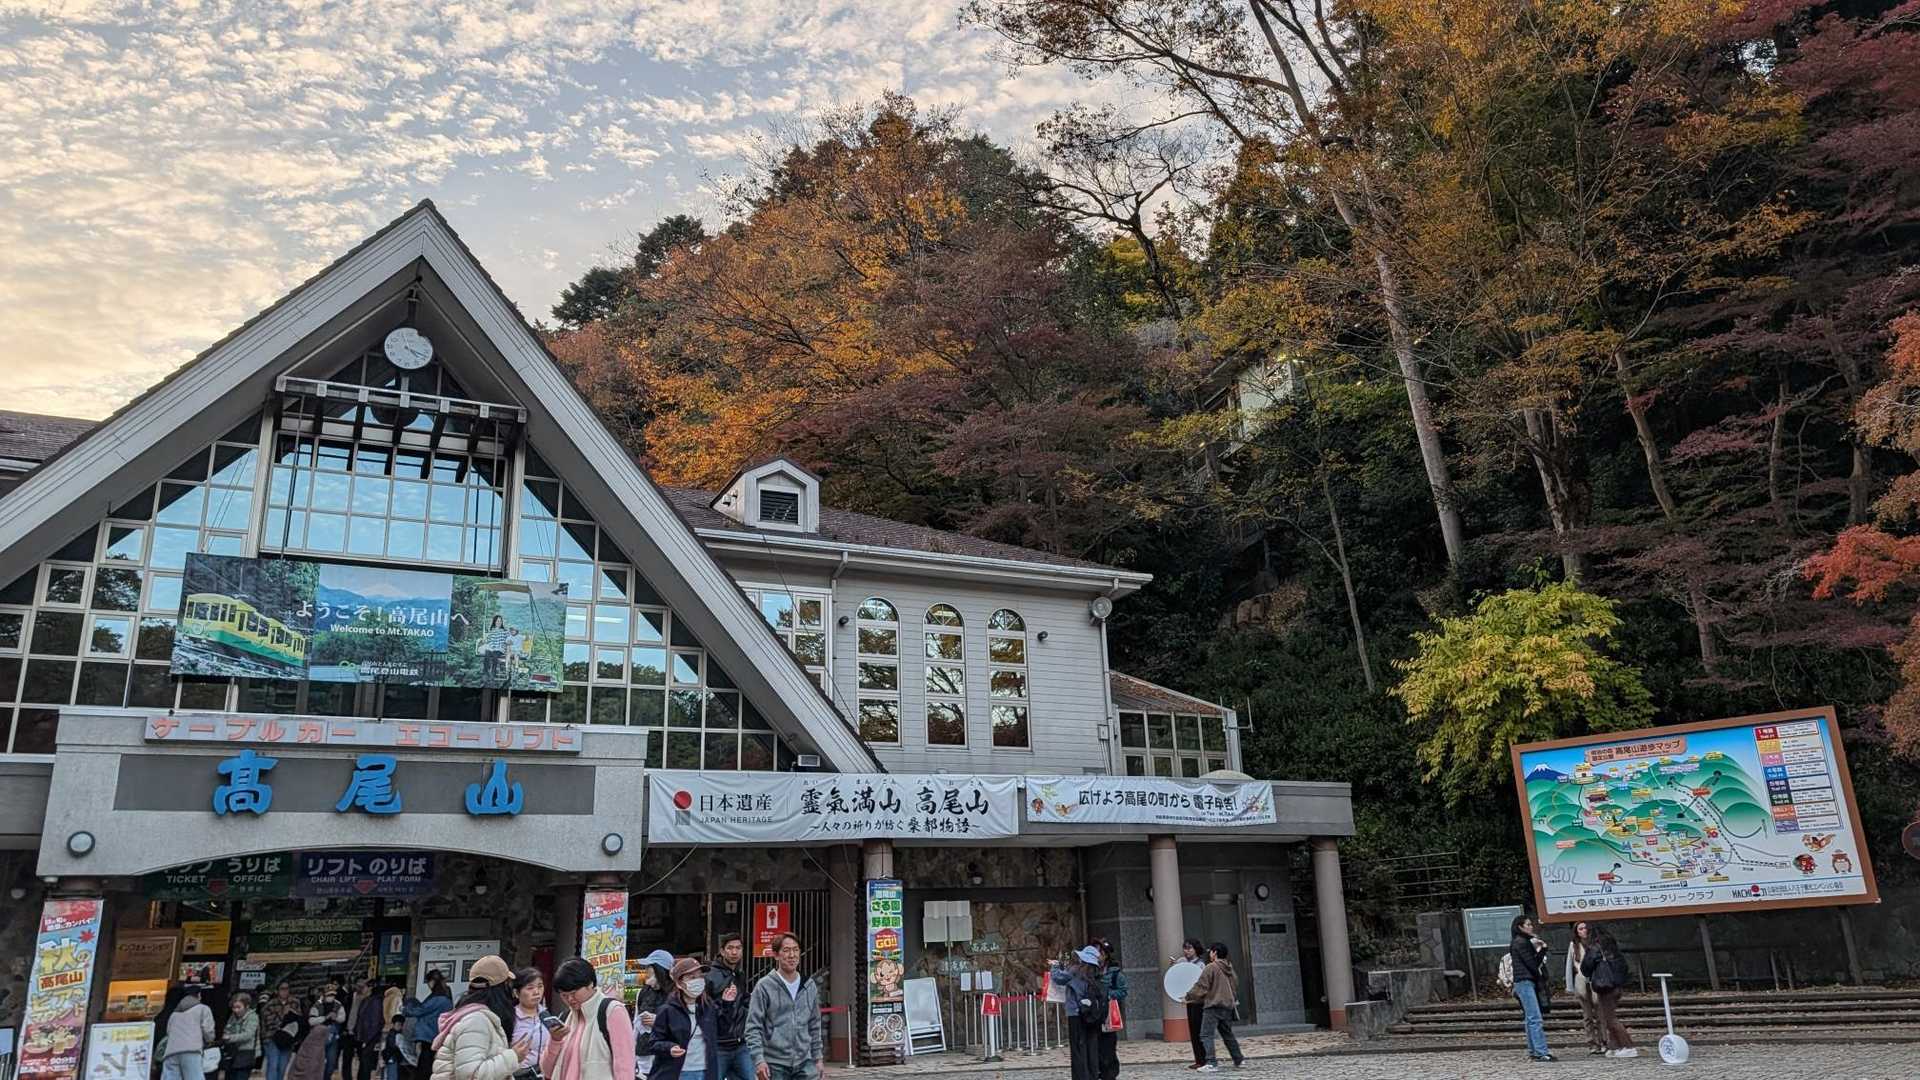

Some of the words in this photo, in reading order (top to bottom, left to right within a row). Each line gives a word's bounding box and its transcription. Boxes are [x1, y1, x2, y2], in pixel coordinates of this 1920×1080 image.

[296, 601, 470, 626] ようこそ！高尾山へ
[330, 624, 374, 634] Welcome
[375, 627, 385, 635] to
[388, 627, 434, 637] Mt.TAKAO
[151, 718, 355, 743] ケーブルカー
[399, 726, 574, 750] エコーリフト
[211, 749, 523, 816] 高尾山
[699, 794, 773, 812] 日本遺産
[916, 786, 990, 815] 高尾山
[1079, 790, 1191, 808] 広げよう高尾の町から
[699, 815, 736, 825] JAPAN
[738, 815, 773, 824] HERITAGE
[227, 856, 281, 873] うりば
[308, 858, 362, 875] リフト
[369, 857, 427, 875] のりば
[166, 875, 206, 883] TICKET
[233, 874, 272, 883] OFFICE
[1588, 890, 1714, 907] 東京八王子北ロータリークラブ
[40, 972, 83, 989] 高尾山
